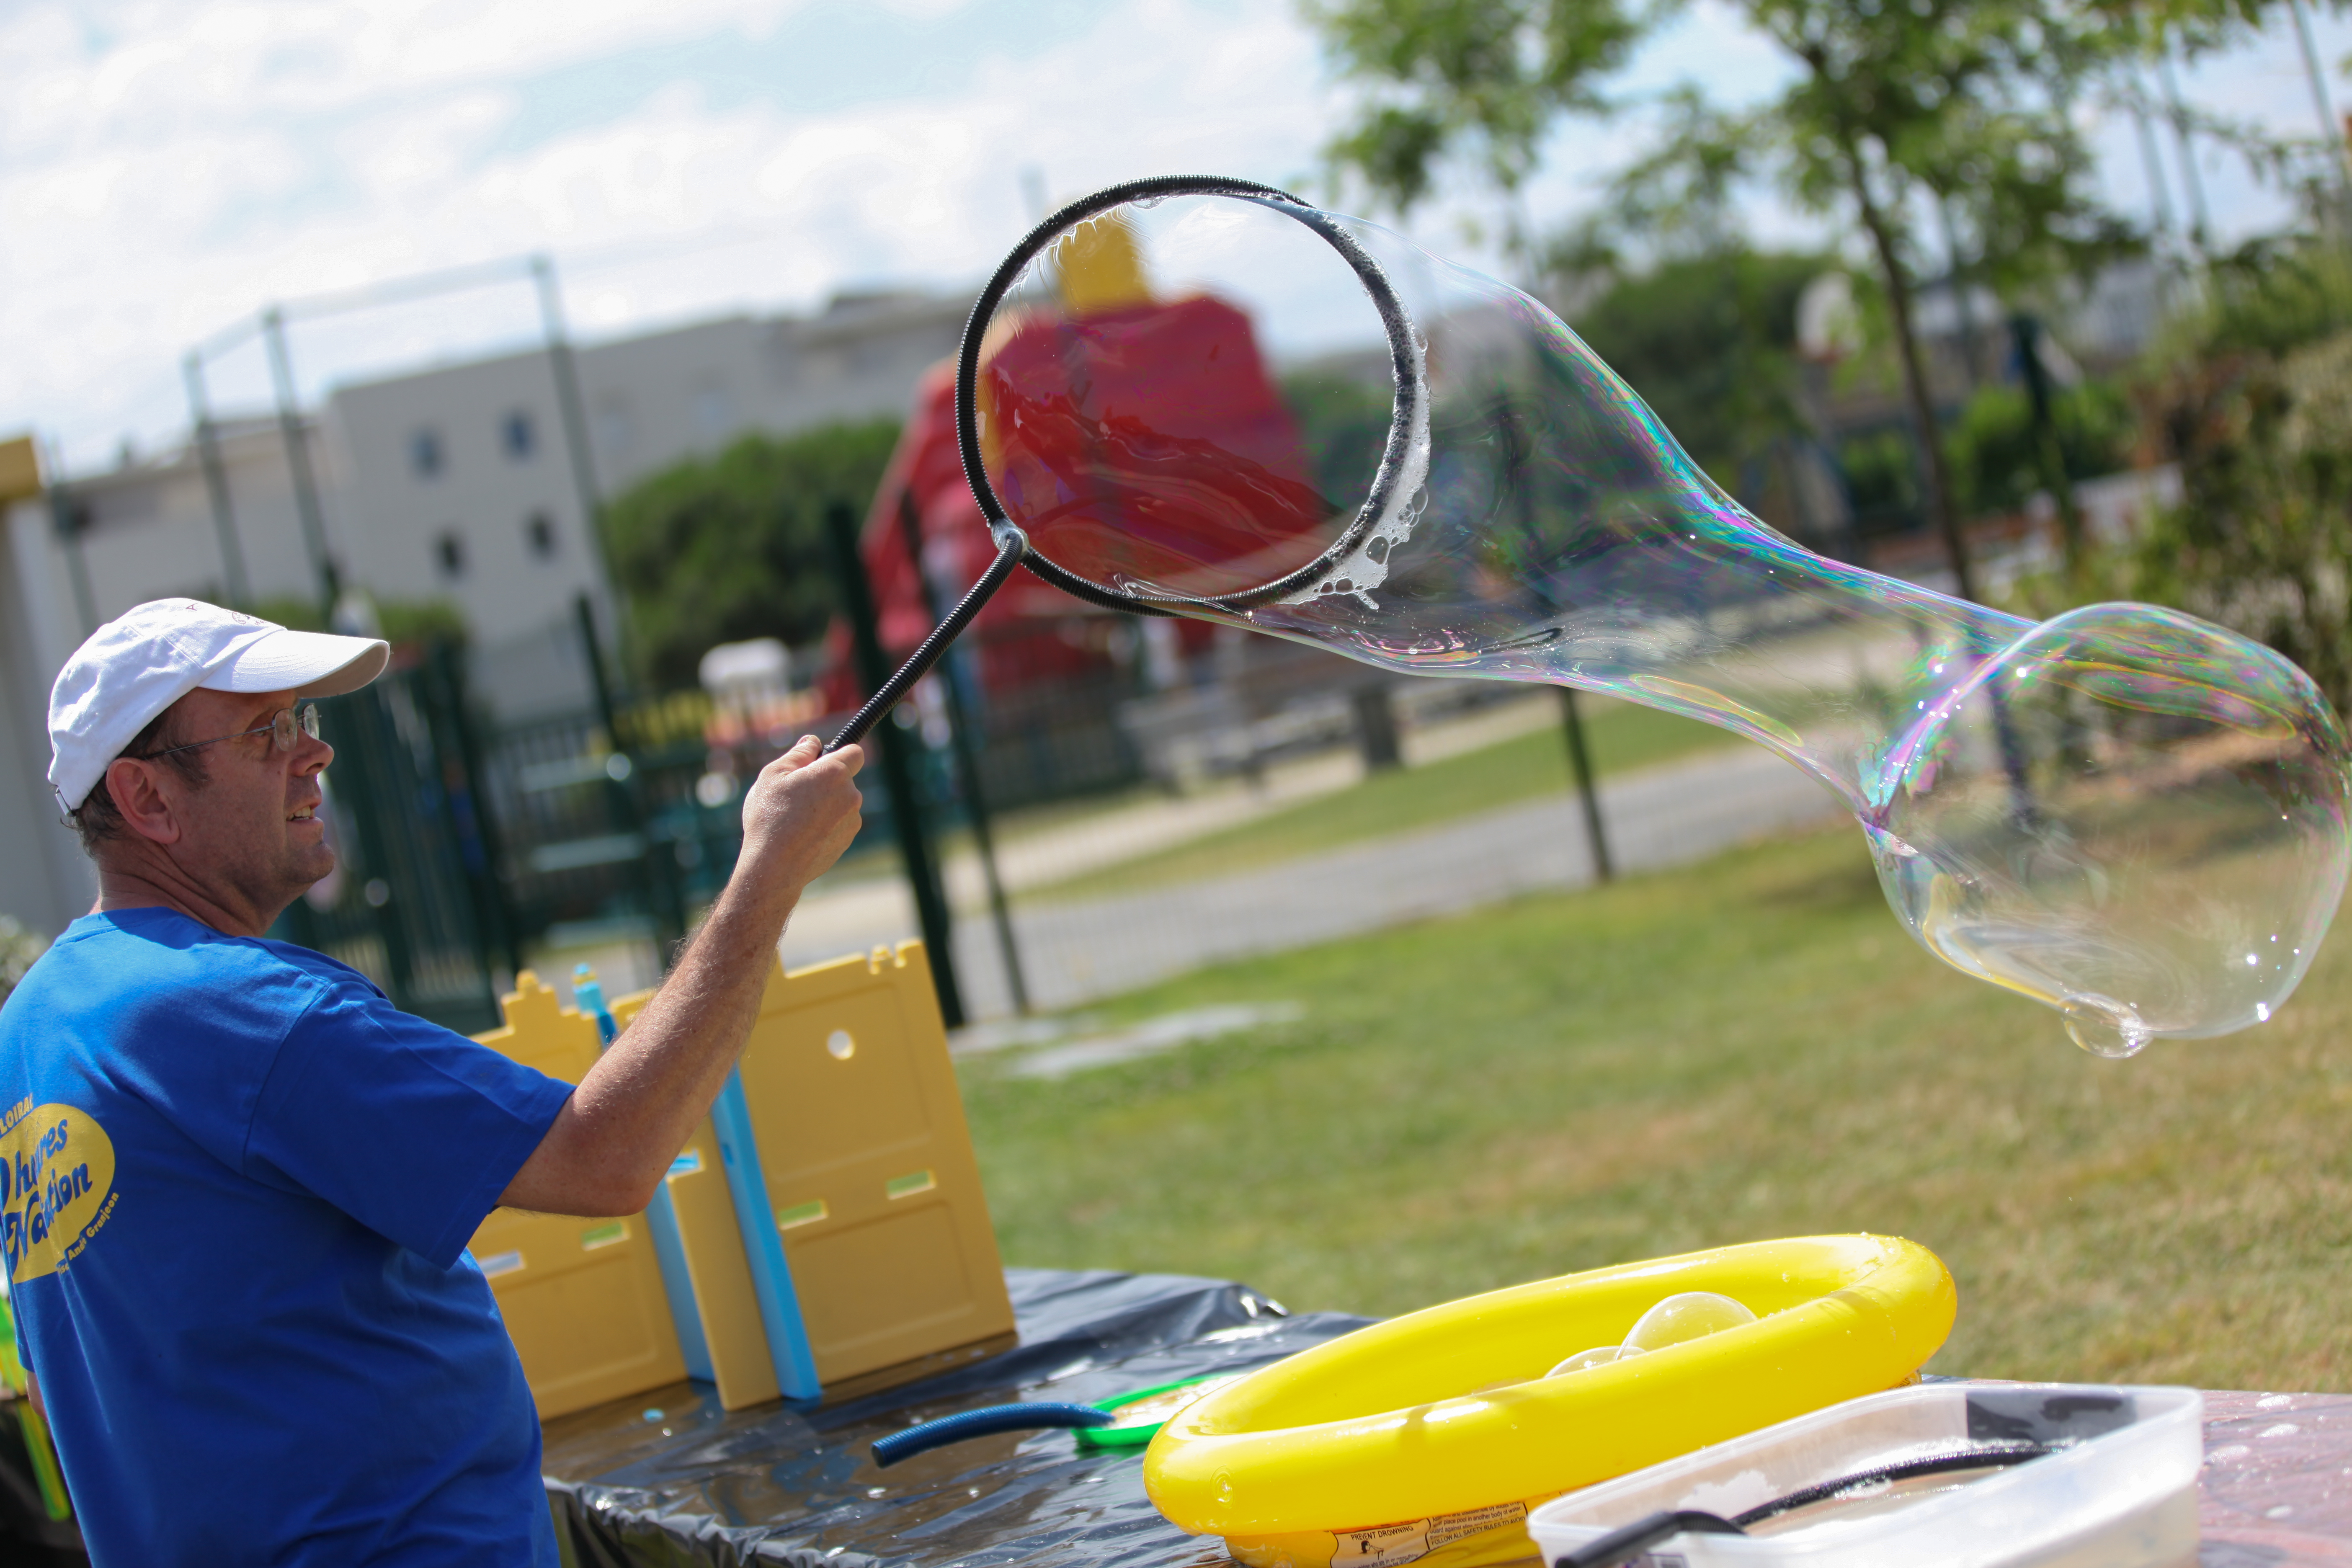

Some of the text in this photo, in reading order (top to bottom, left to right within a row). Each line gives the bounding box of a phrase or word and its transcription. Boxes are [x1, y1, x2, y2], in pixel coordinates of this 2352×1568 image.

[86, 1192, 119, 1238] Granjeon
[1350, 1525, 1414, 1541] PREVENT DROWNING
[1431, 1534, 1453, 1546] FOLLOW
[1463, 1526, 1483, 1536] SAFETY
[1484, 1522, 1502, 1531] RULES
